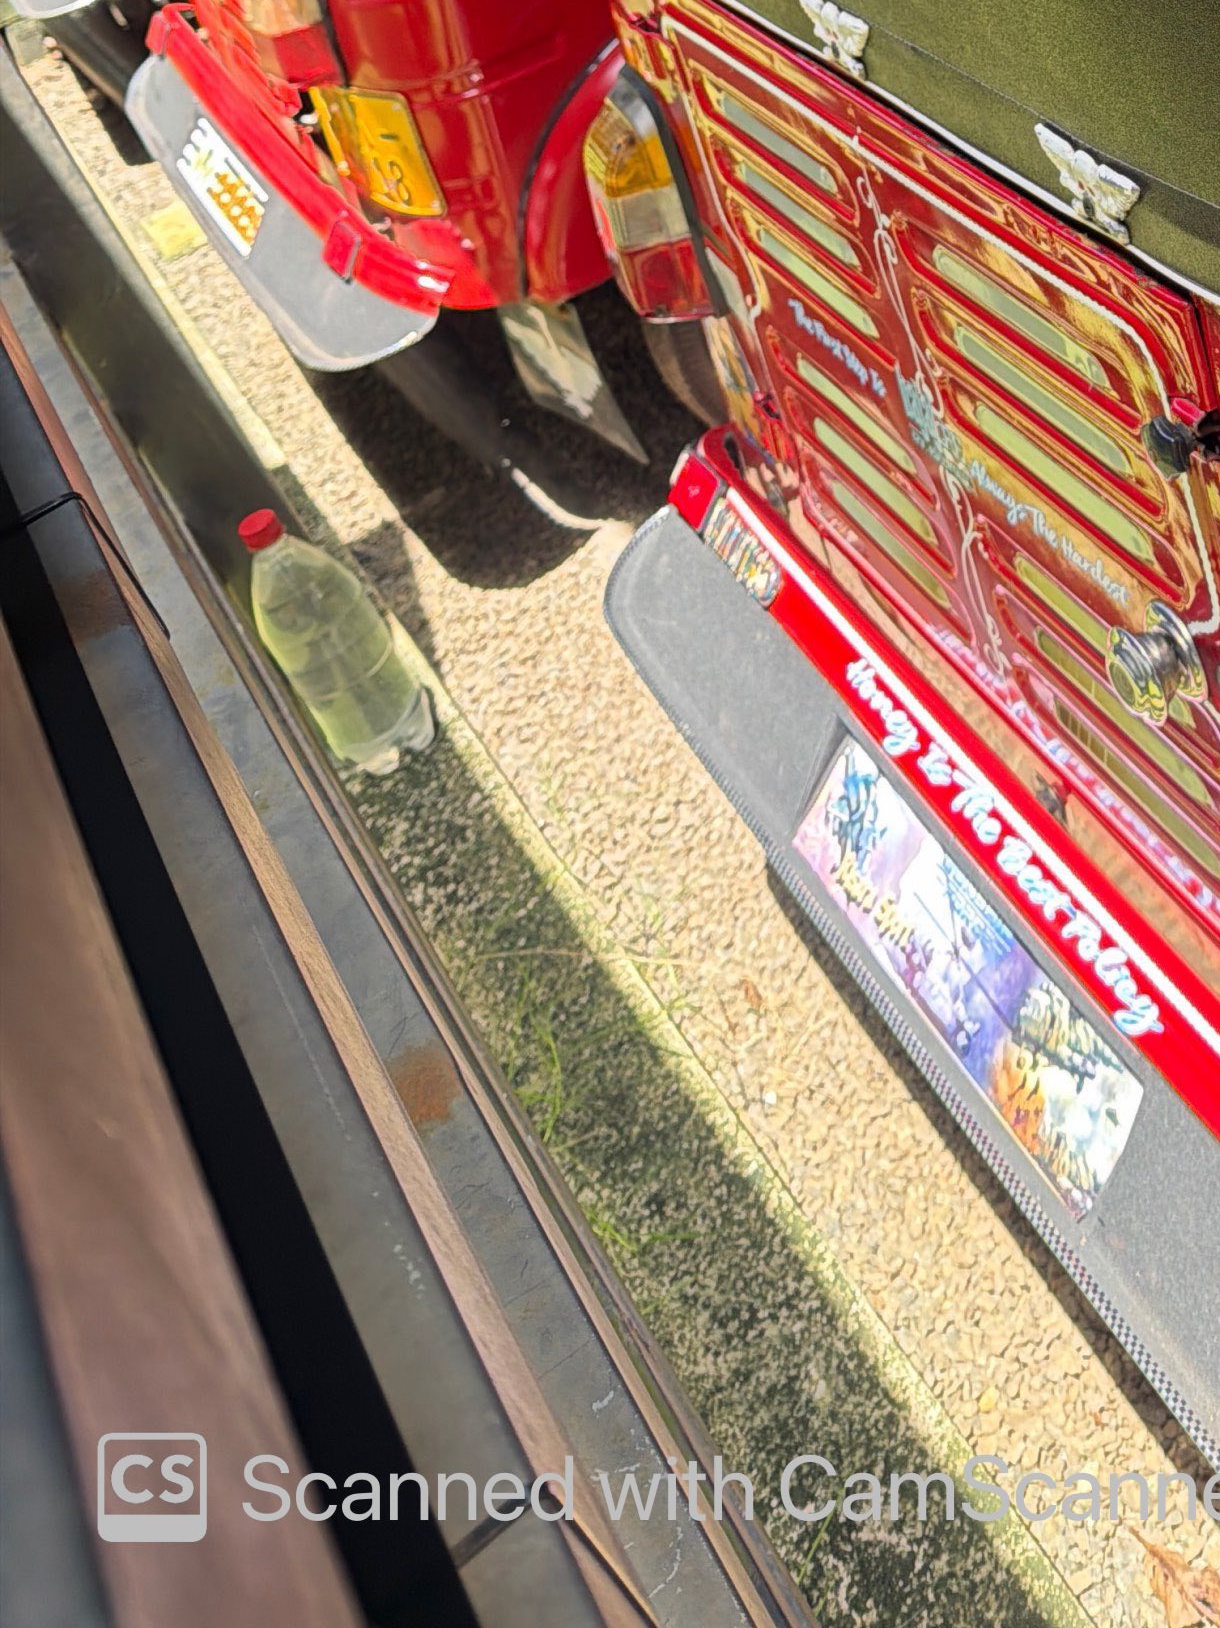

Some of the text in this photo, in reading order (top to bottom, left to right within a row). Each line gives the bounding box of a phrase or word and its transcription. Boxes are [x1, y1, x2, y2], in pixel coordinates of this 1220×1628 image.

[970, 460, 1130, 608] Always The Hardest
[917, 740, 953, 786] Is
[951, 768, 1003, 845] The
[997, 836, 1075, 921] Best
[1061, 909, 1165, 1035] Policy
